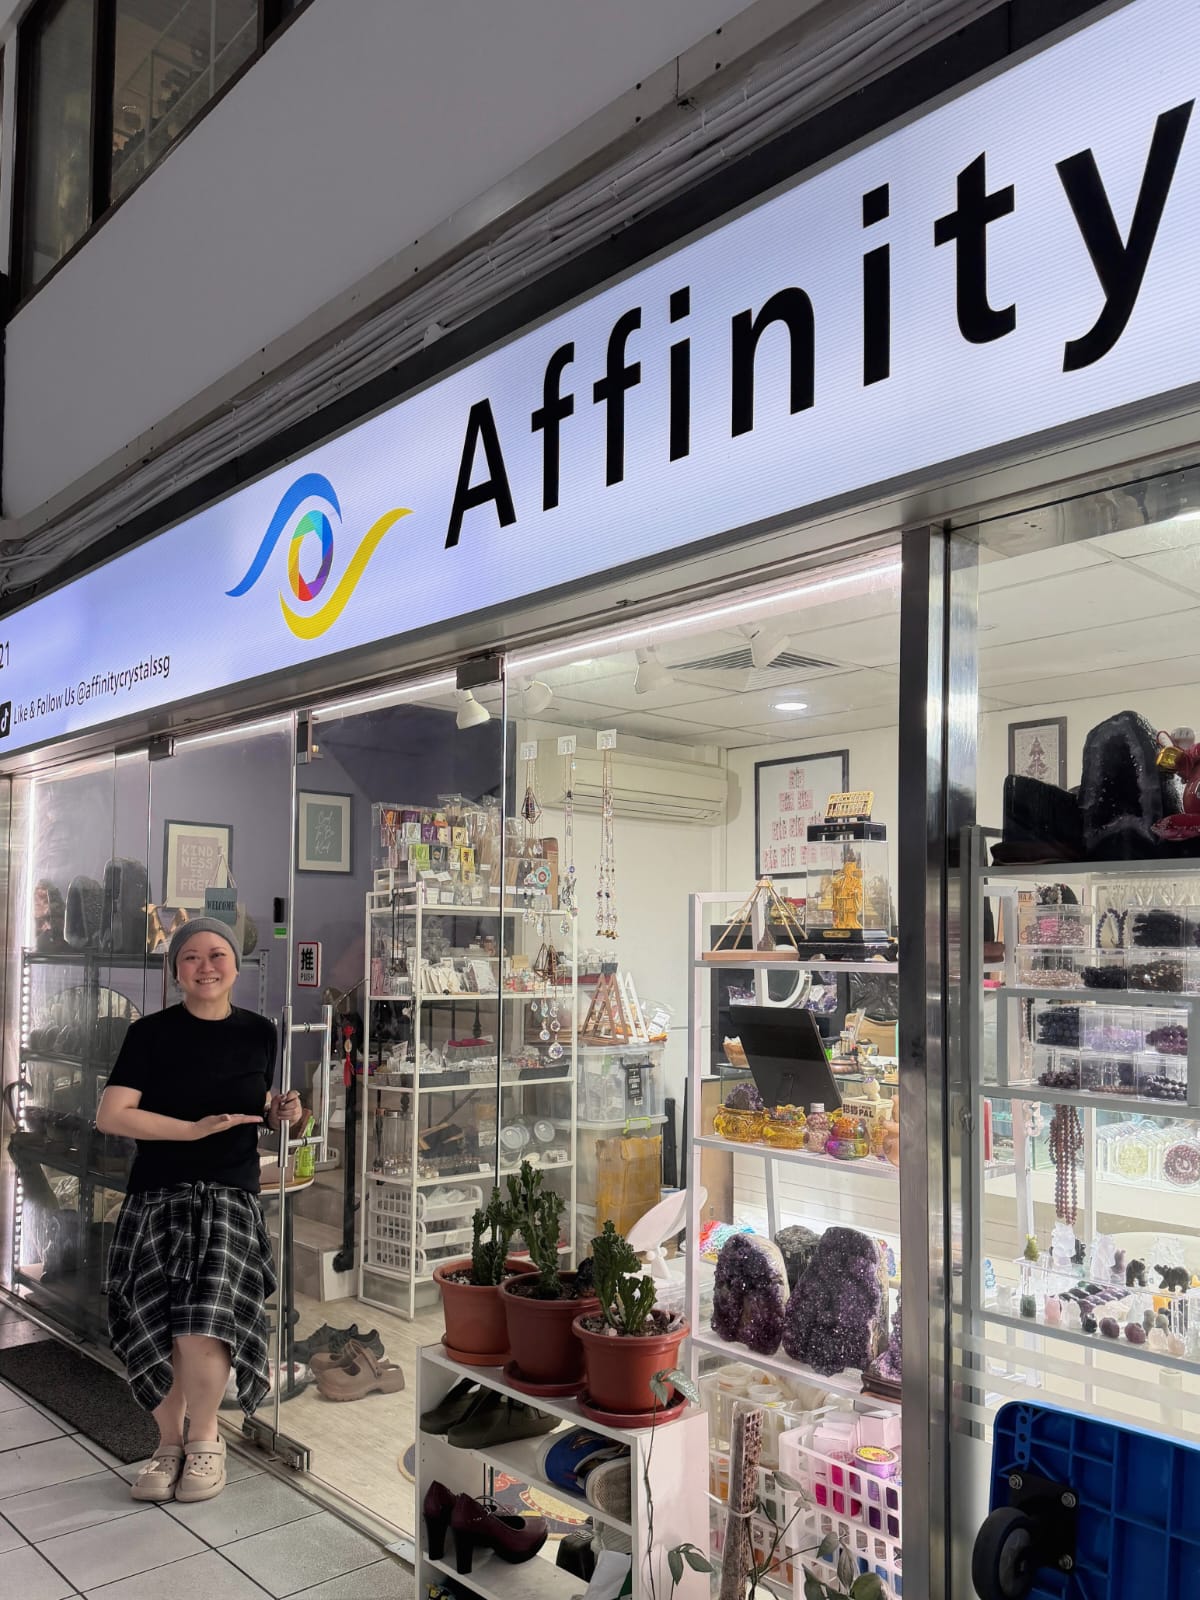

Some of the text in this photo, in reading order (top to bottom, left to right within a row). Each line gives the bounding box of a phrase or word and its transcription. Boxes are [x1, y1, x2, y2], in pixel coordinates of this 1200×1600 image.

[444, 98, 1195, 549] Affinity
[14, 654, 170, 725] Like & Follow Us @affinitycrystalssg
[181, 844, 214, 857] KIND
[181, 857, 214, 869] NESS
[207, 900, 236, 911] WELCOME
[300, 948, 314, 970] 推
[300, 973, 314, 982] PUSH
